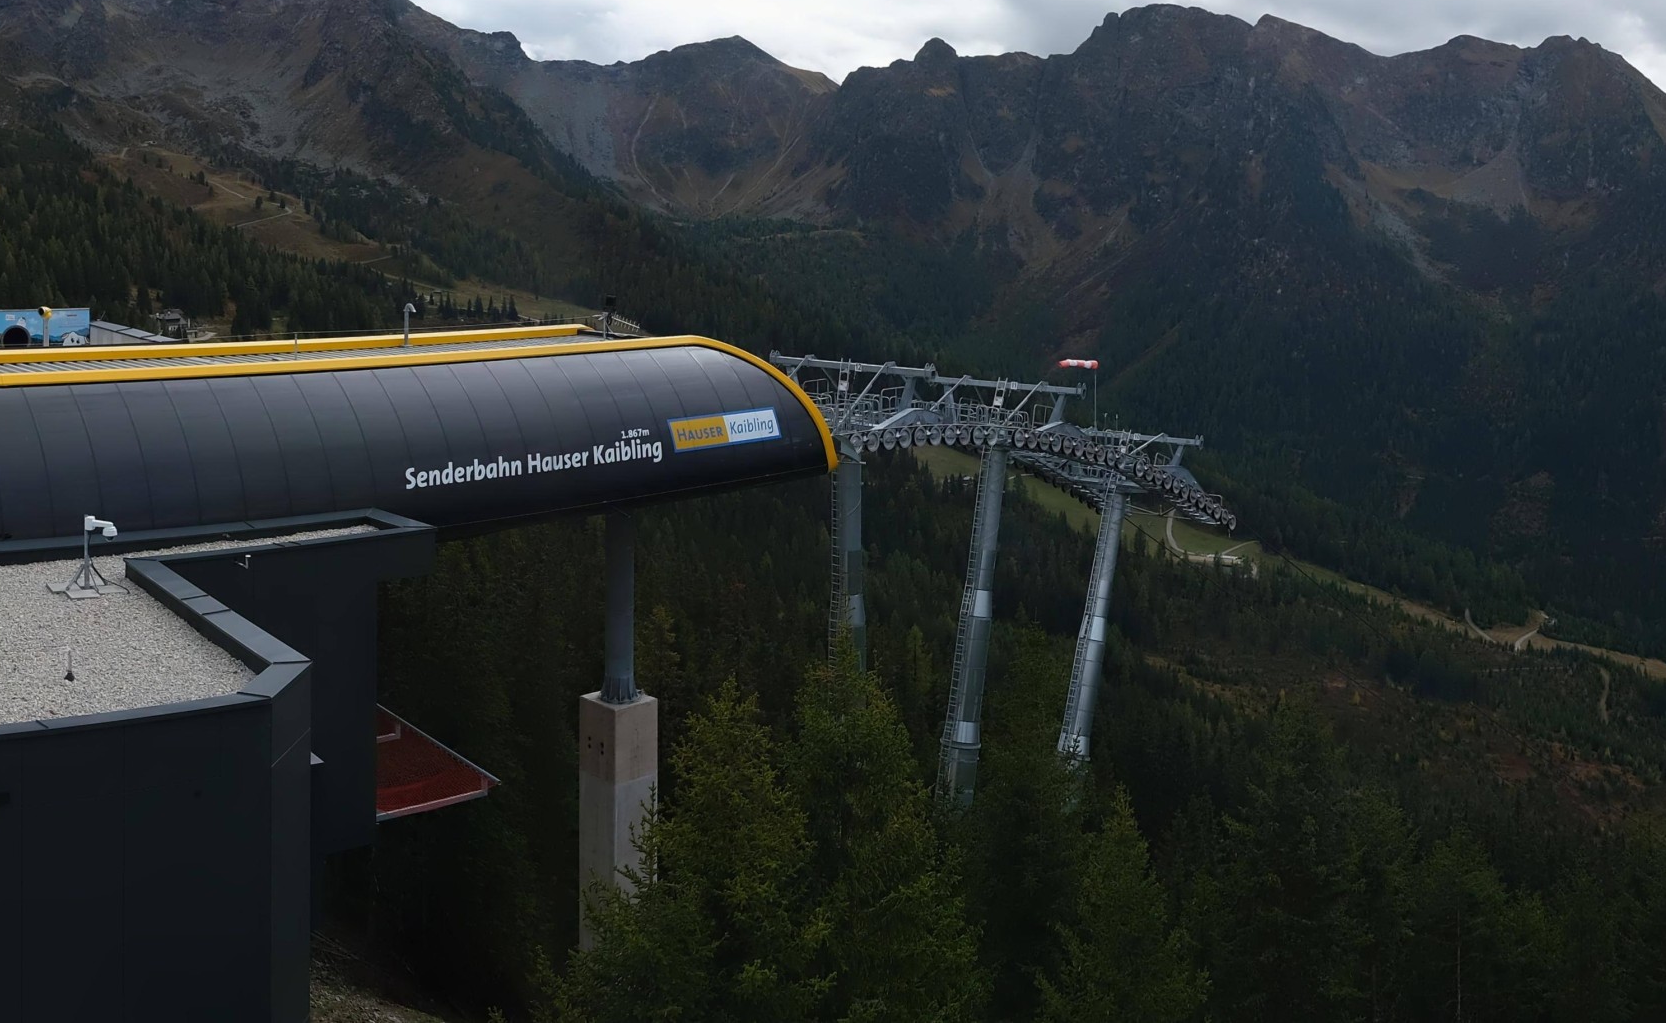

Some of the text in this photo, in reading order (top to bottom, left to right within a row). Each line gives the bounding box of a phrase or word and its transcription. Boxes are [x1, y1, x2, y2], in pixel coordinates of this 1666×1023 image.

[620, 428, 650, 440] 1.867m
[676, 417, 774, 442] HAUSER Kaibling
[405, 439, 663, 490] Senderbahn Hauser Kaibling
